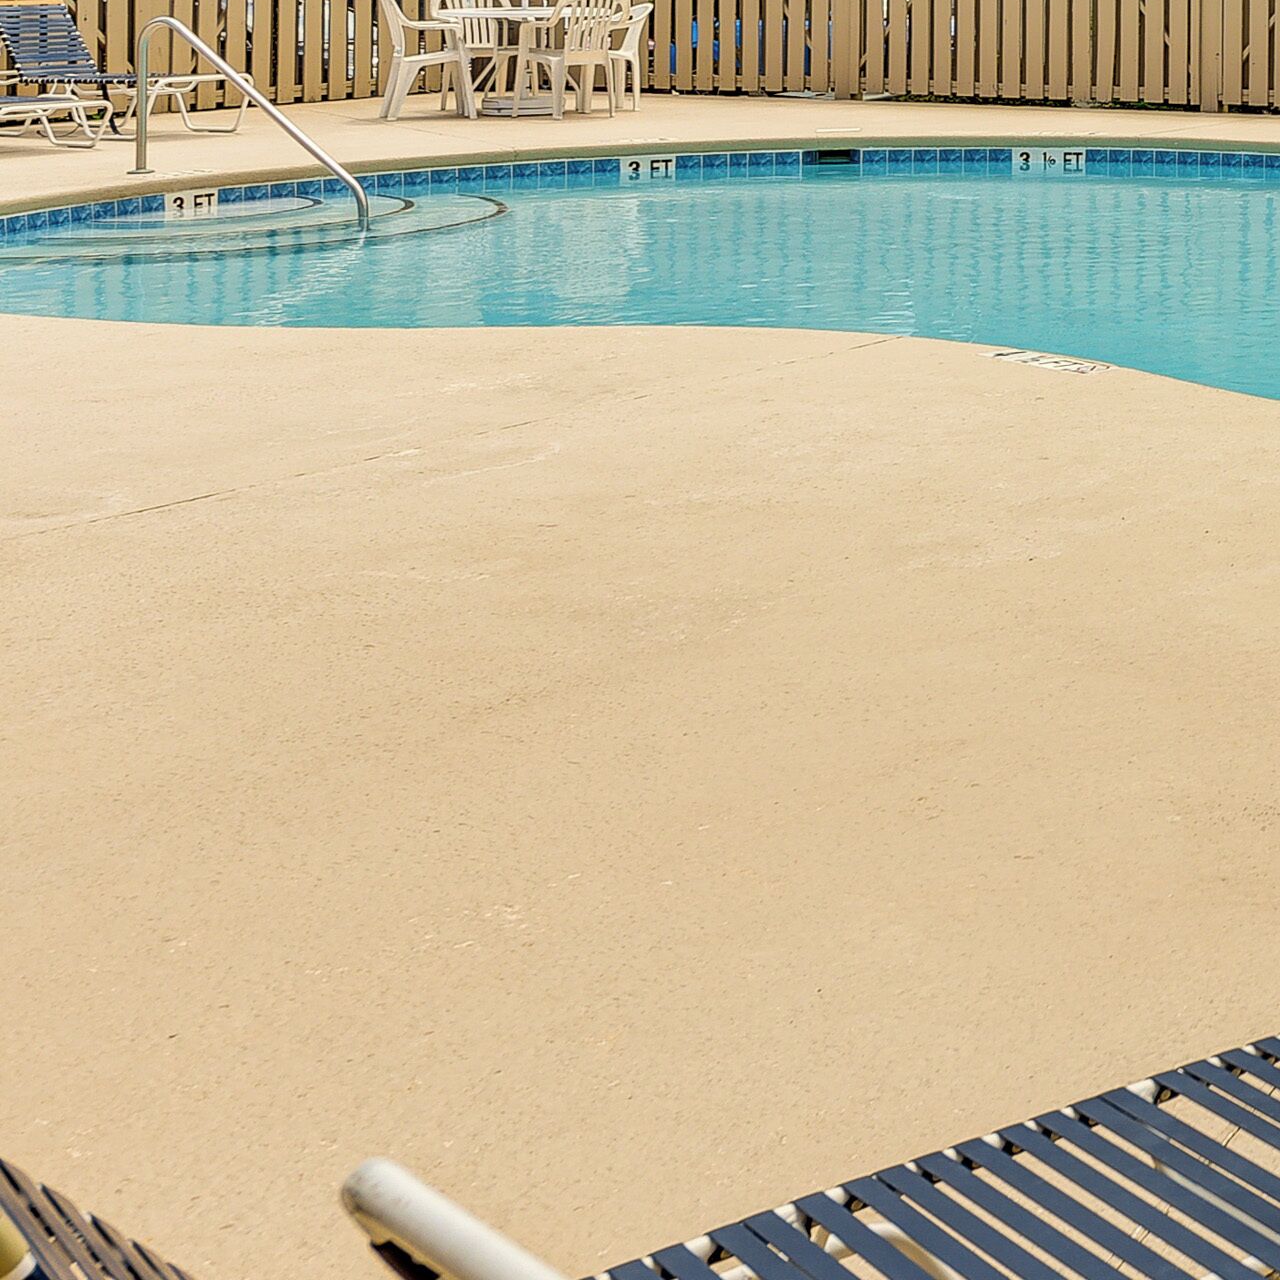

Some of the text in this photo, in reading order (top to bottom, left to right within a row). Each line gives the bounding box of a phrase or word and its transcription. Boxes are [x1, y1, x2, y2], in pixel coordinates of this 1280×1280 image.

[628, 159, 673, 175] 3 FT
[1020, 152, 1030, 166] 3
[1063, 152, 1083, 167] FT
[173, 193, 215, 210] 3 FT
